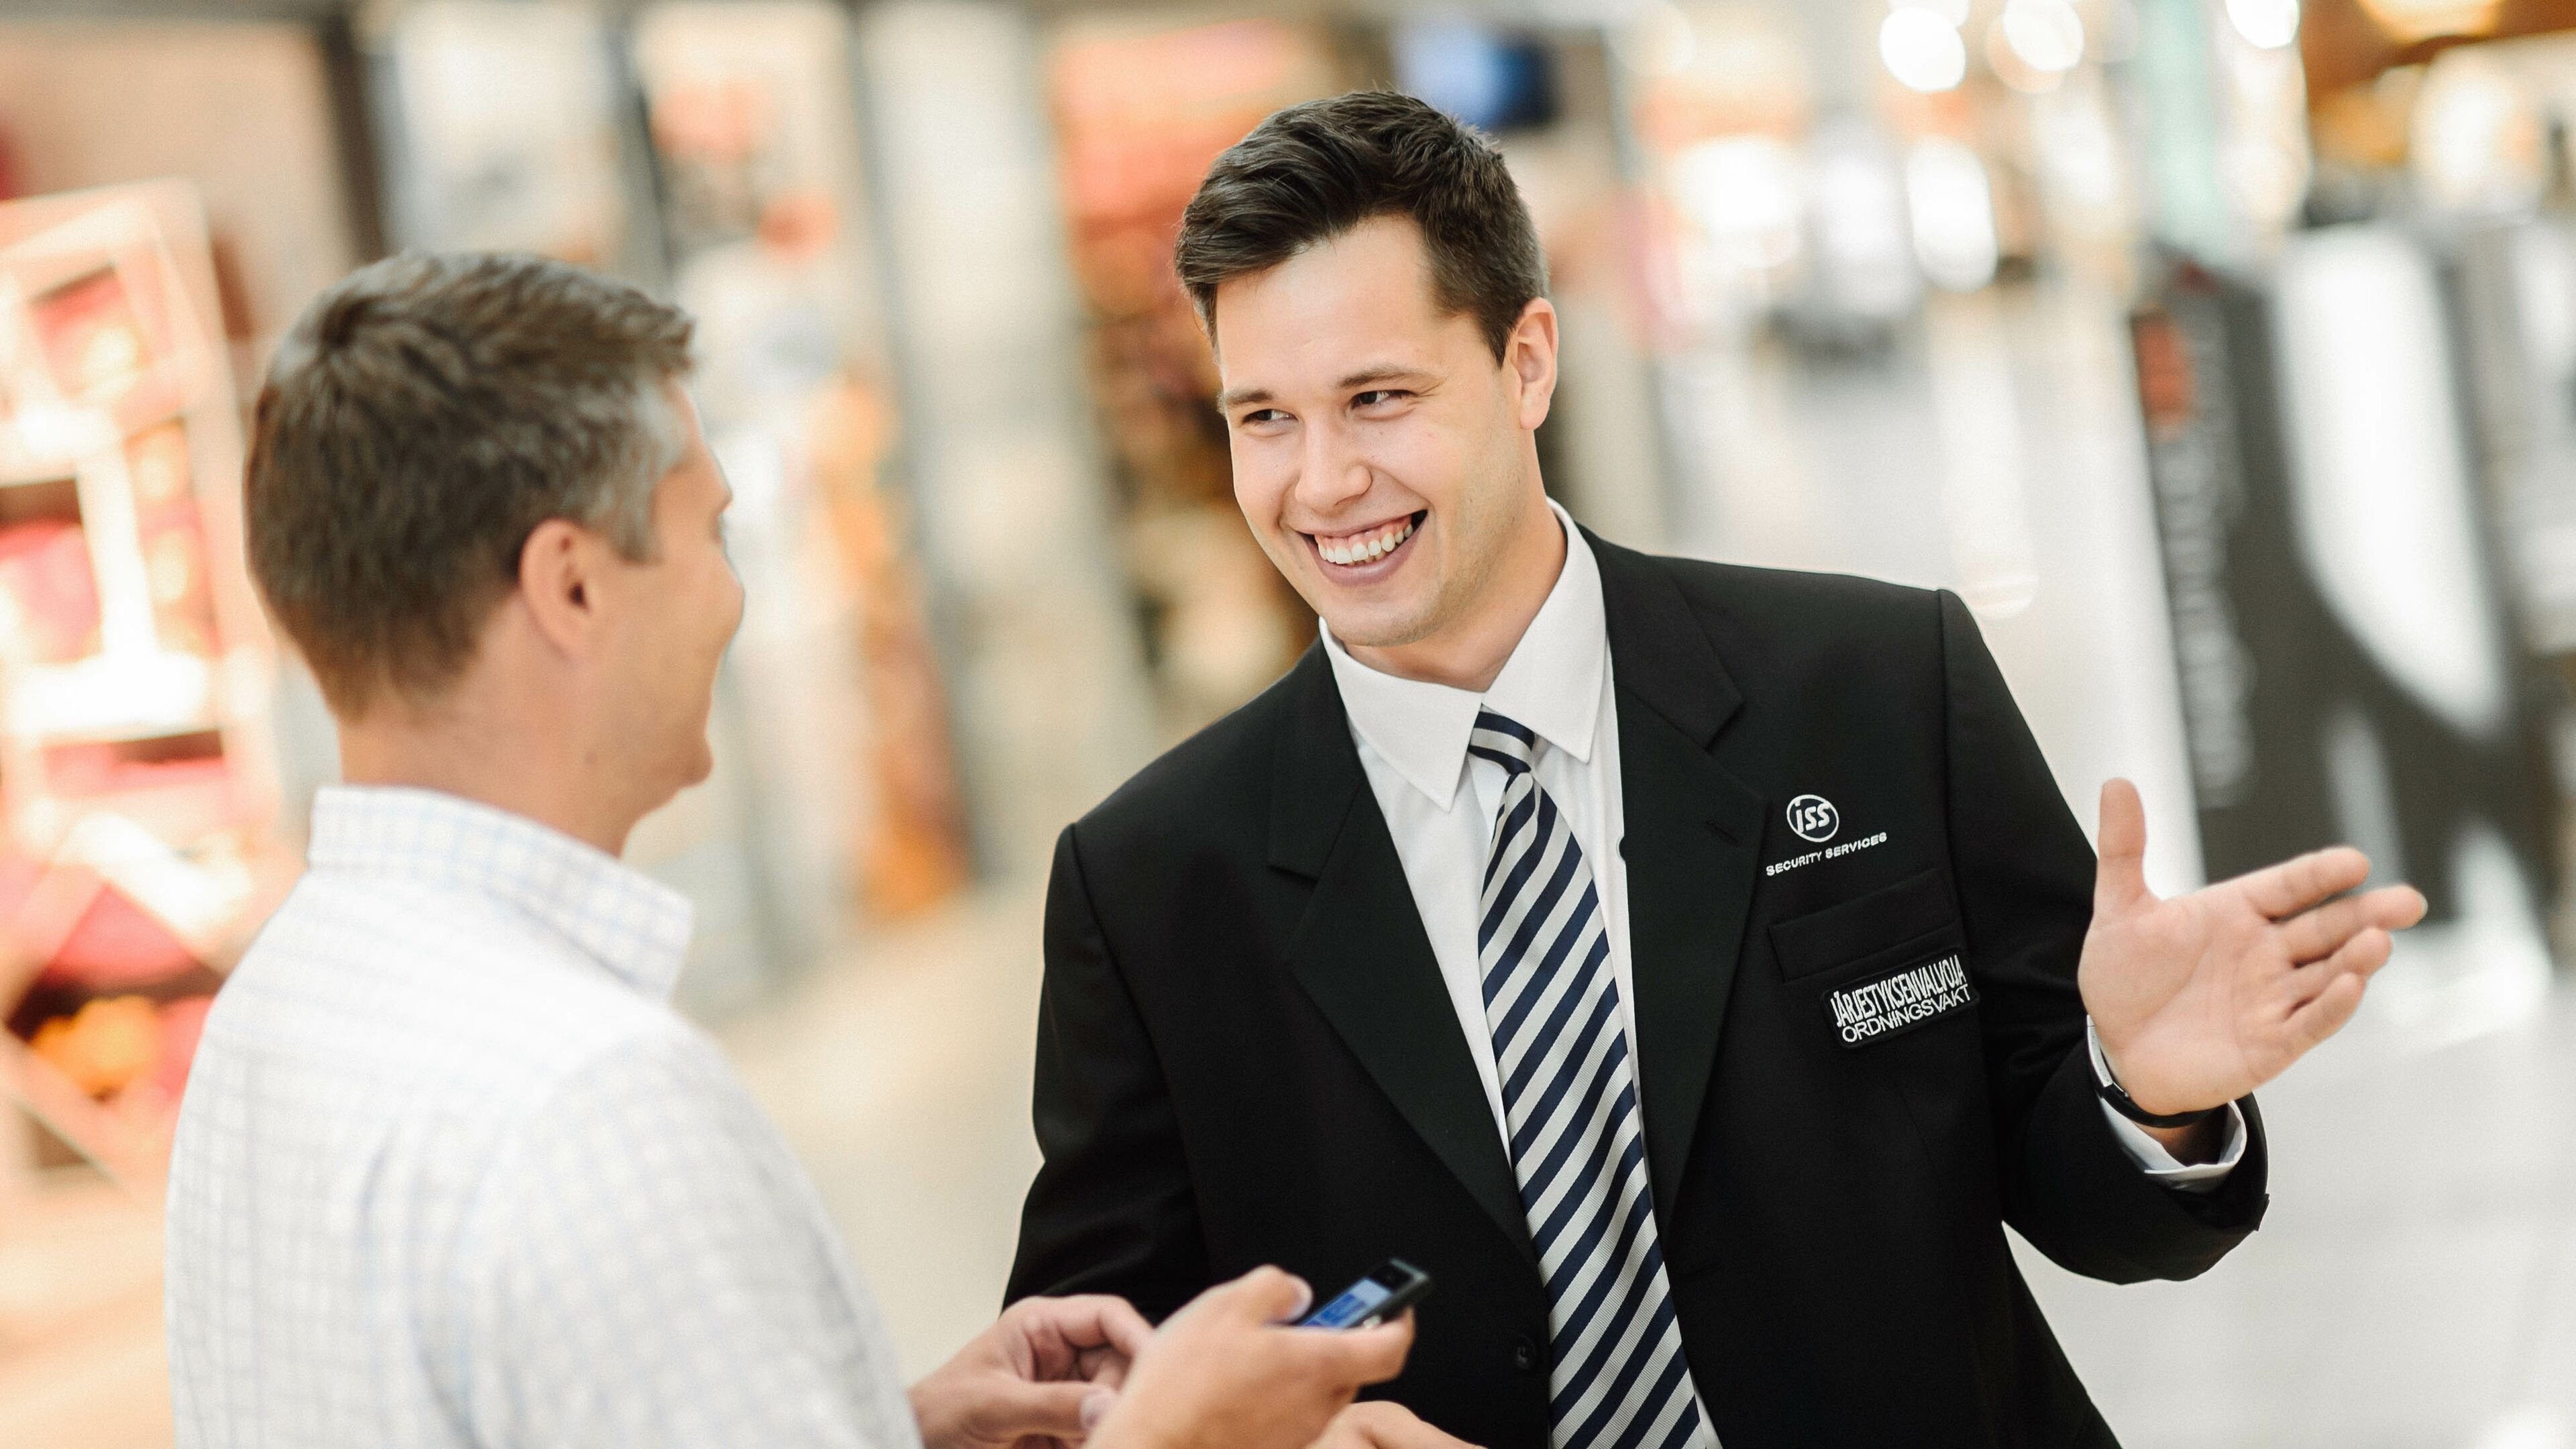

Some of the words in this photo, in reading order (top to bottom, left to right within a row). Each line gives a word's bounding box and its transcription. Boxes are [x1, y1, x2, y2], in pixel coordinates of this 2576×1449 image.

[1766, 851, 1822, 876] SECURITY
[1825, 832, 1887, 859] SERVICES
[1830, 954, 1967, 1028] JÄRJESTYKSENVALVOJA
[1841, 983, 1970, 1042] ORDNINGSVAKT
